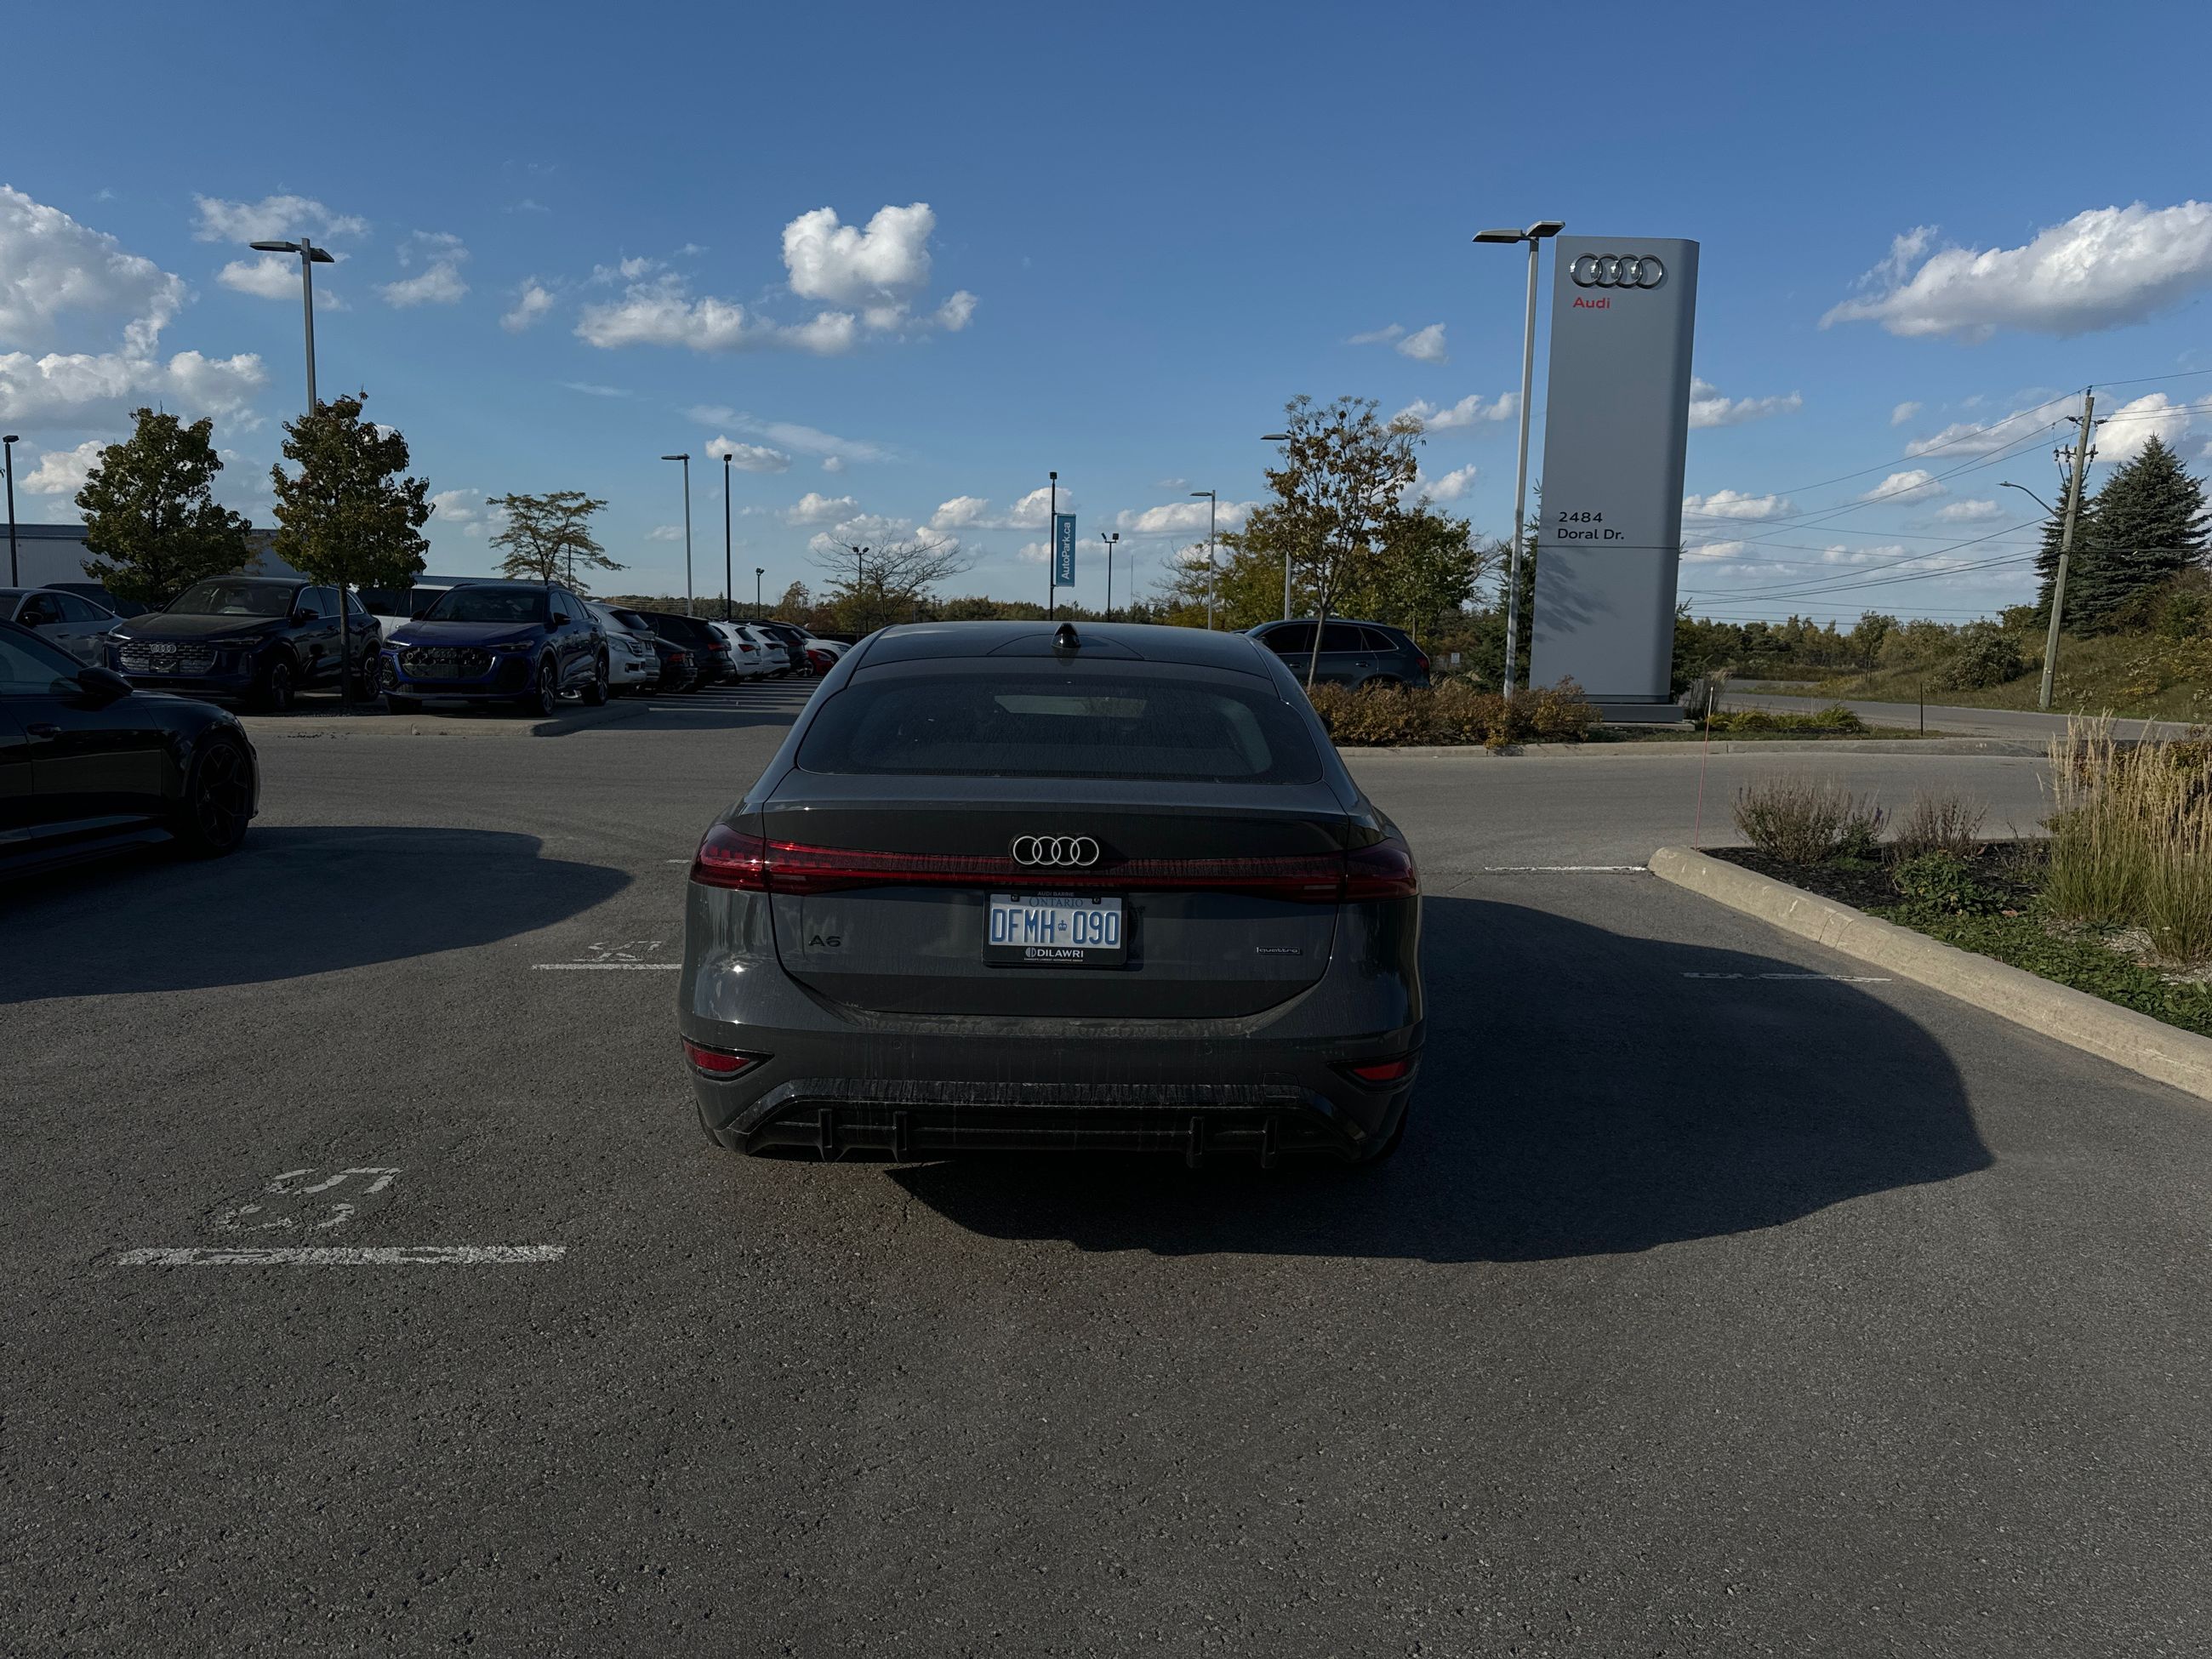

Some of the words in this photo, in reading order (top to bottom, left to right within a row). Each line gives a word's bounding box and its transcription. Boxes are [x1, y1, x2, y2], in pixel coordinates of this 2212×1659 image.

[1572, 297, 1611, 308] Audi
[1559, 511, 1603, 522] 2484
[1558, 528, 1599, 539] Doral
[1604, 528, 1624, 539] Dr.
[1061, 522, 1071, 580] AutoPark.ca
[1029, 897, 1083, 908] ONTARIO
[991, 909, 1055, 944] DFMH
[1072, 910, 1119, 945] 090
[808, 935, 841, 947] A6
[1037, 949, 1084, 958] DILAWRI
